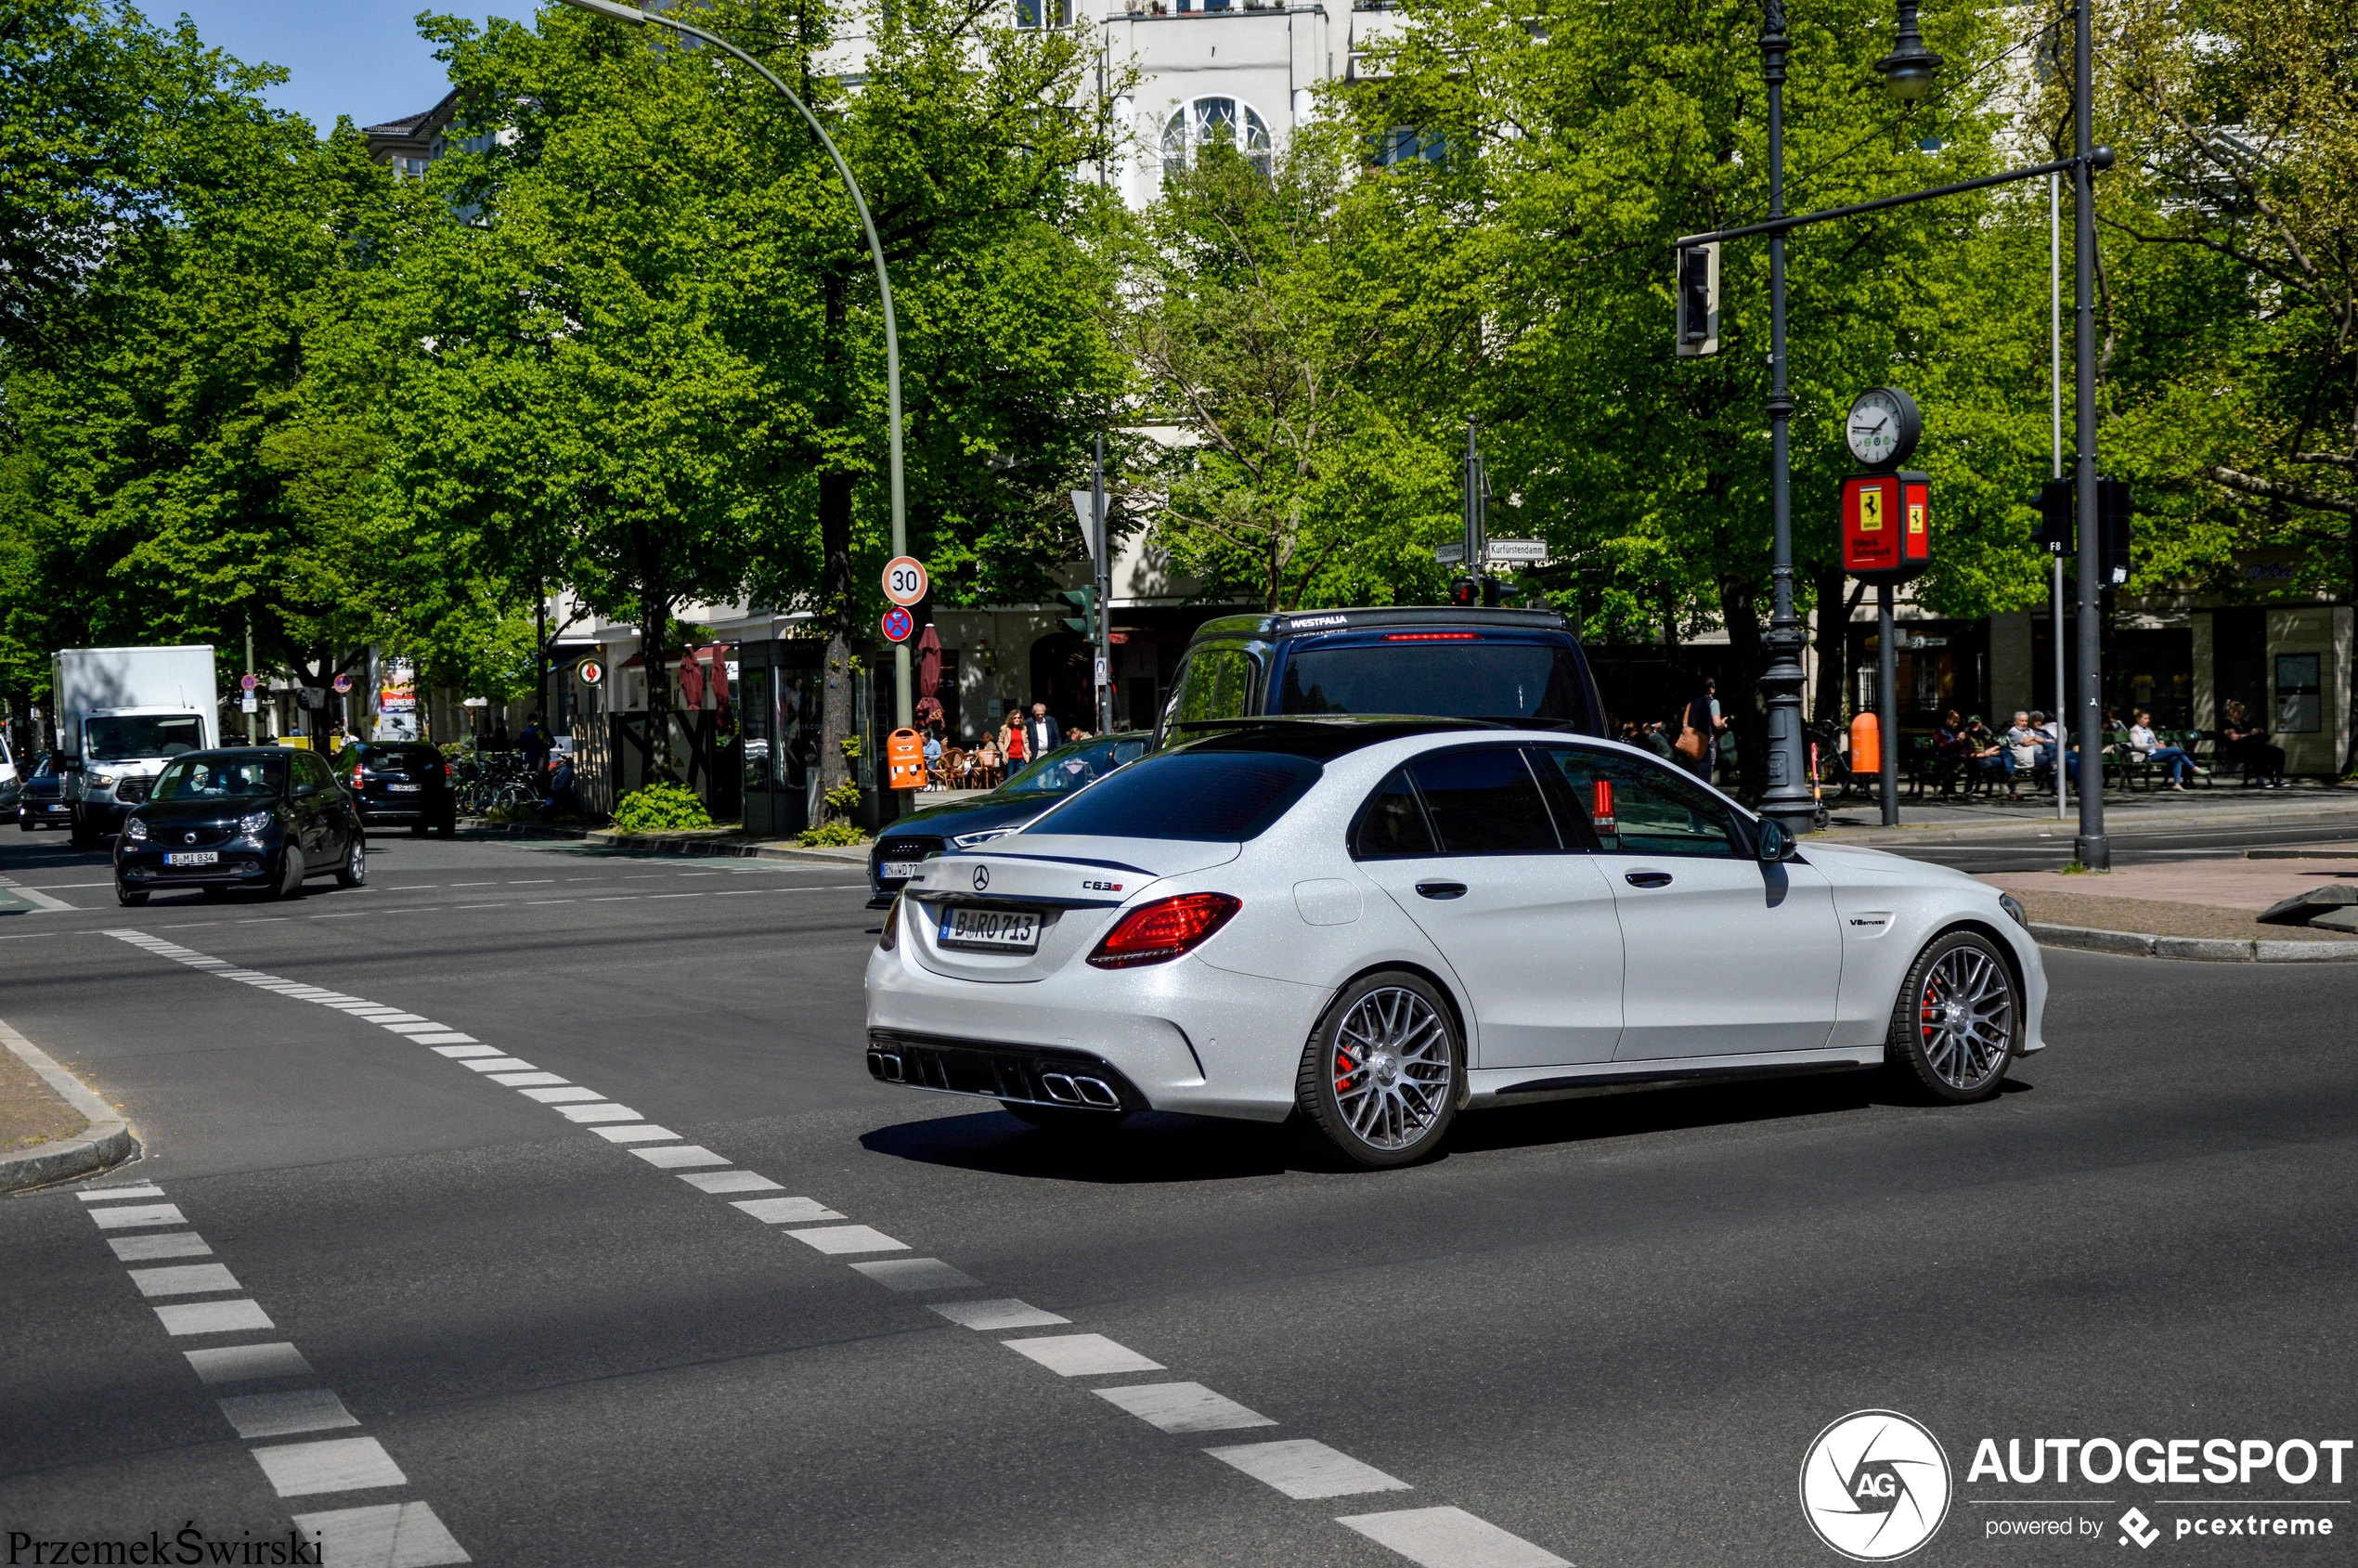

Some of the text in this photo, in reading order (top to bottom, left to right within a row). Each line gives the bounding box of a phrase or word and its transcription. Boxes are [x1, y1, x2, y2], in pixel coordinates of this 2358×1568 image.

[1491, 544, 1543, 554] Kurfürstendamm
[2050, 541, 2061, 551] F8
[892, 570, 917, 592] 30
[1290, 615, 1348, 628] WESTFALIA
[172, 853, 214, 863] B MI 834
[885, 864, 893, 875] RN
[898, 864, 907, 875] WD
[954, 911, 967, 937] B
[977, 914, 999, 939] RO
[1000, 914, 1031, 940] 713
